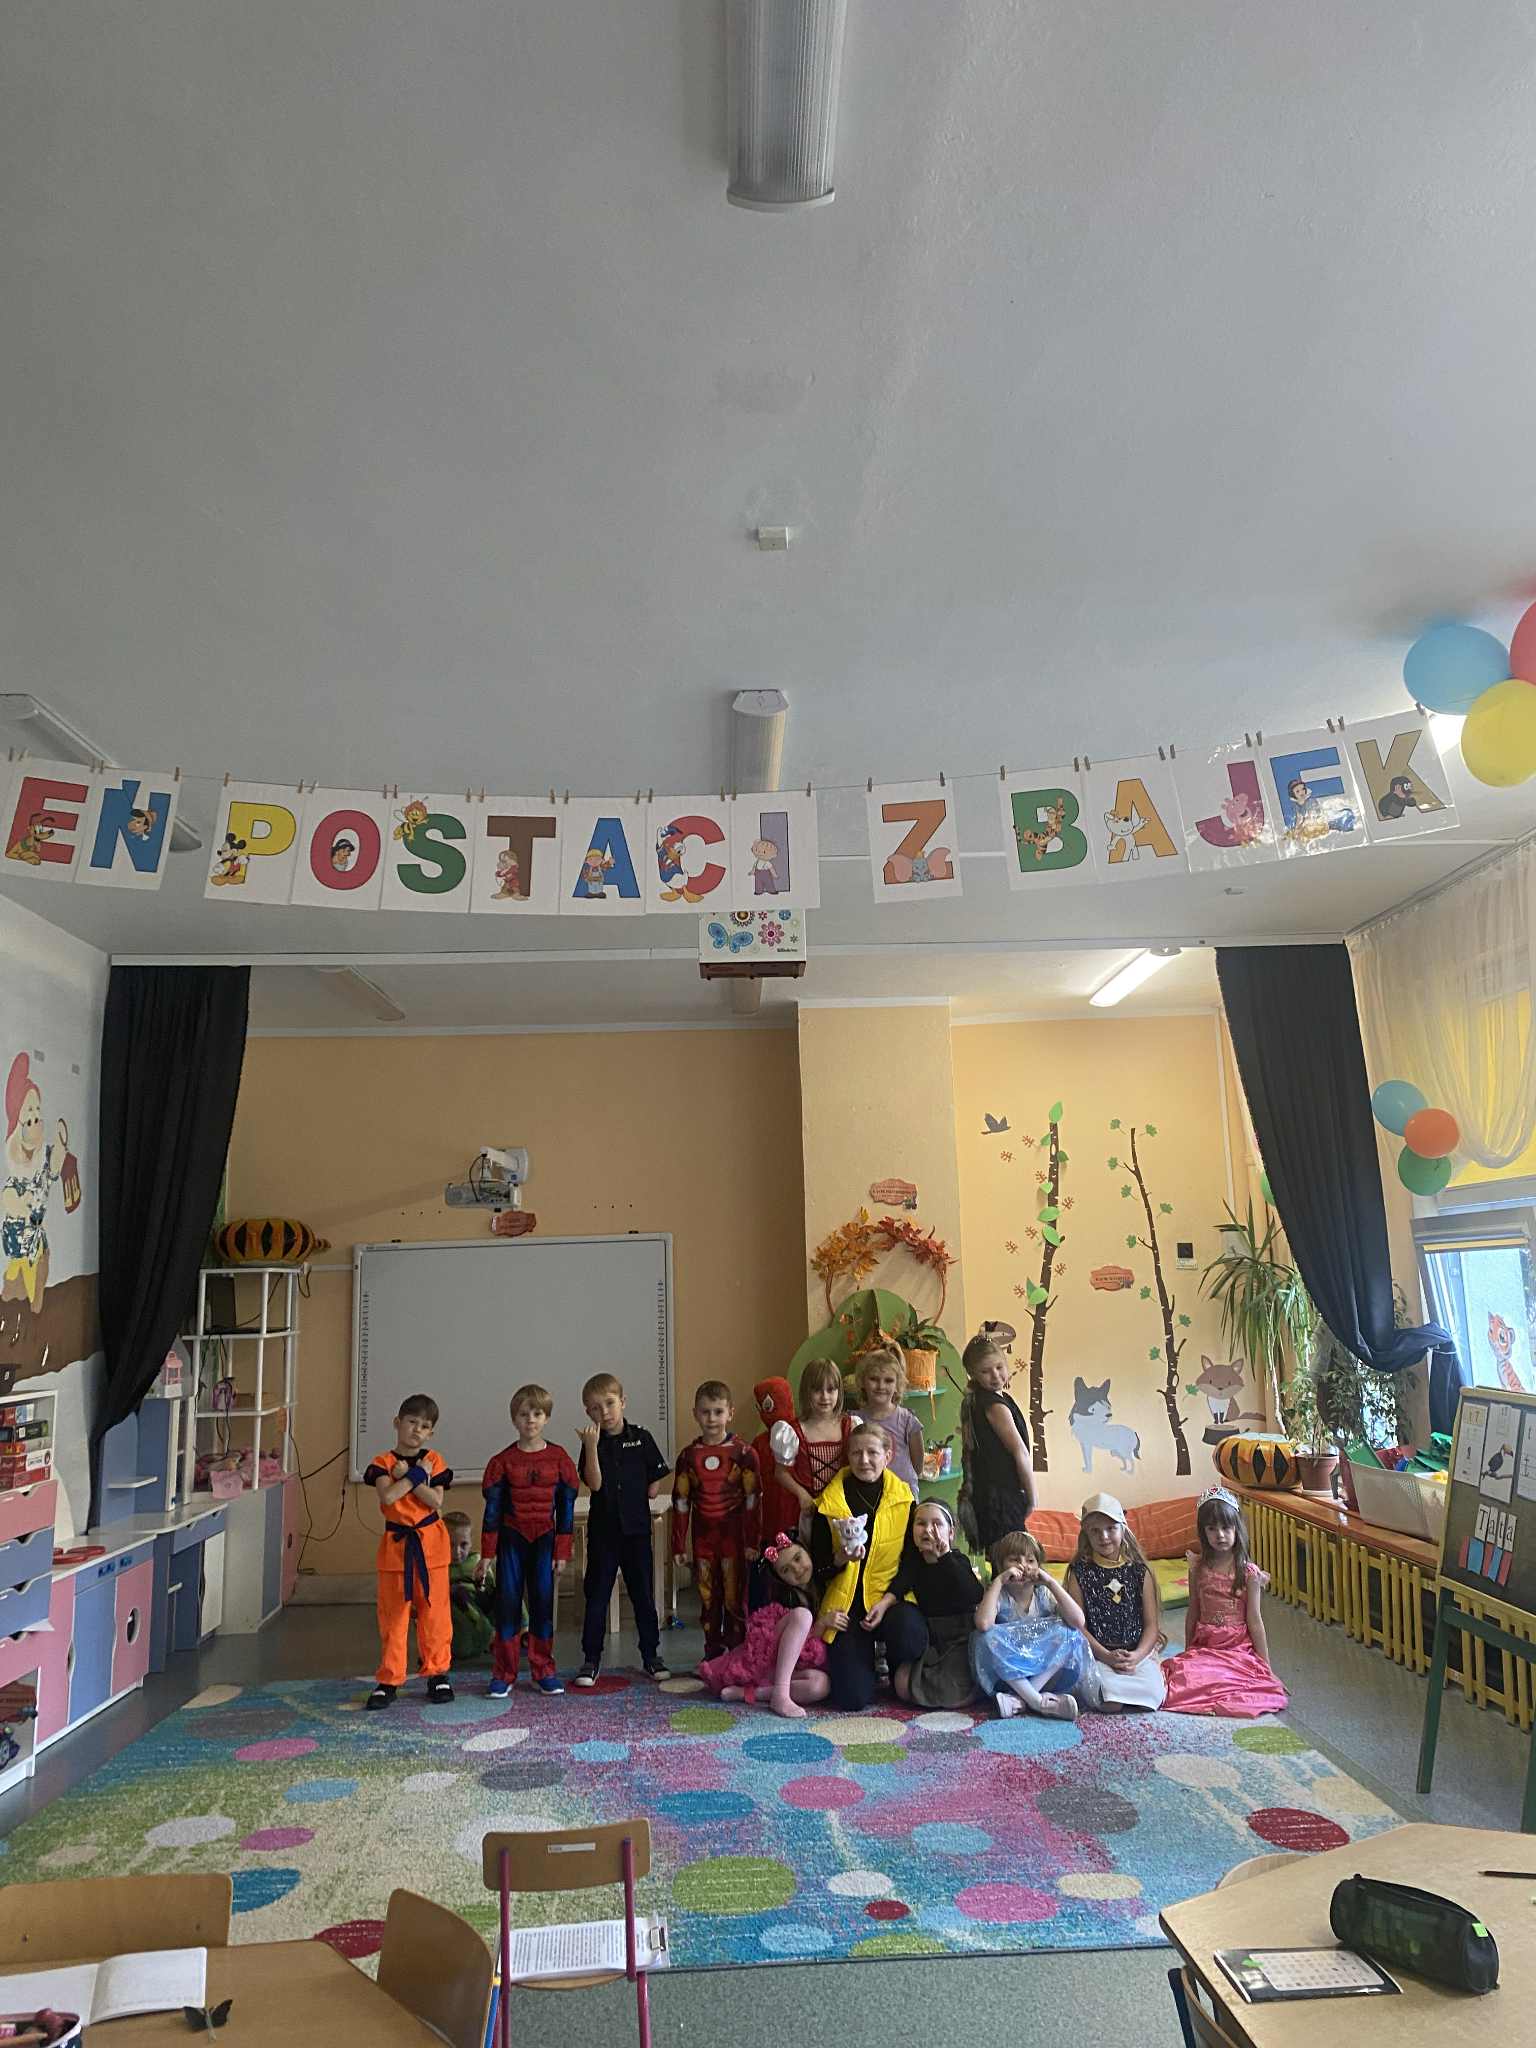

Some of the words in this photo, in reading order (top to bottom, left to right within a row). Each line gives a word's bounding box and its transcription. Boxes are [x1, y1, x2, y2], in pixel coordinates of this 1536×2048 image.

[220, 801, 791, 899] POSTACI
[881, 800, 954, 885] Z
[1011, 729, 1446, 873] BAJEK
[1479, 1508, 1515, 1542] Tata
